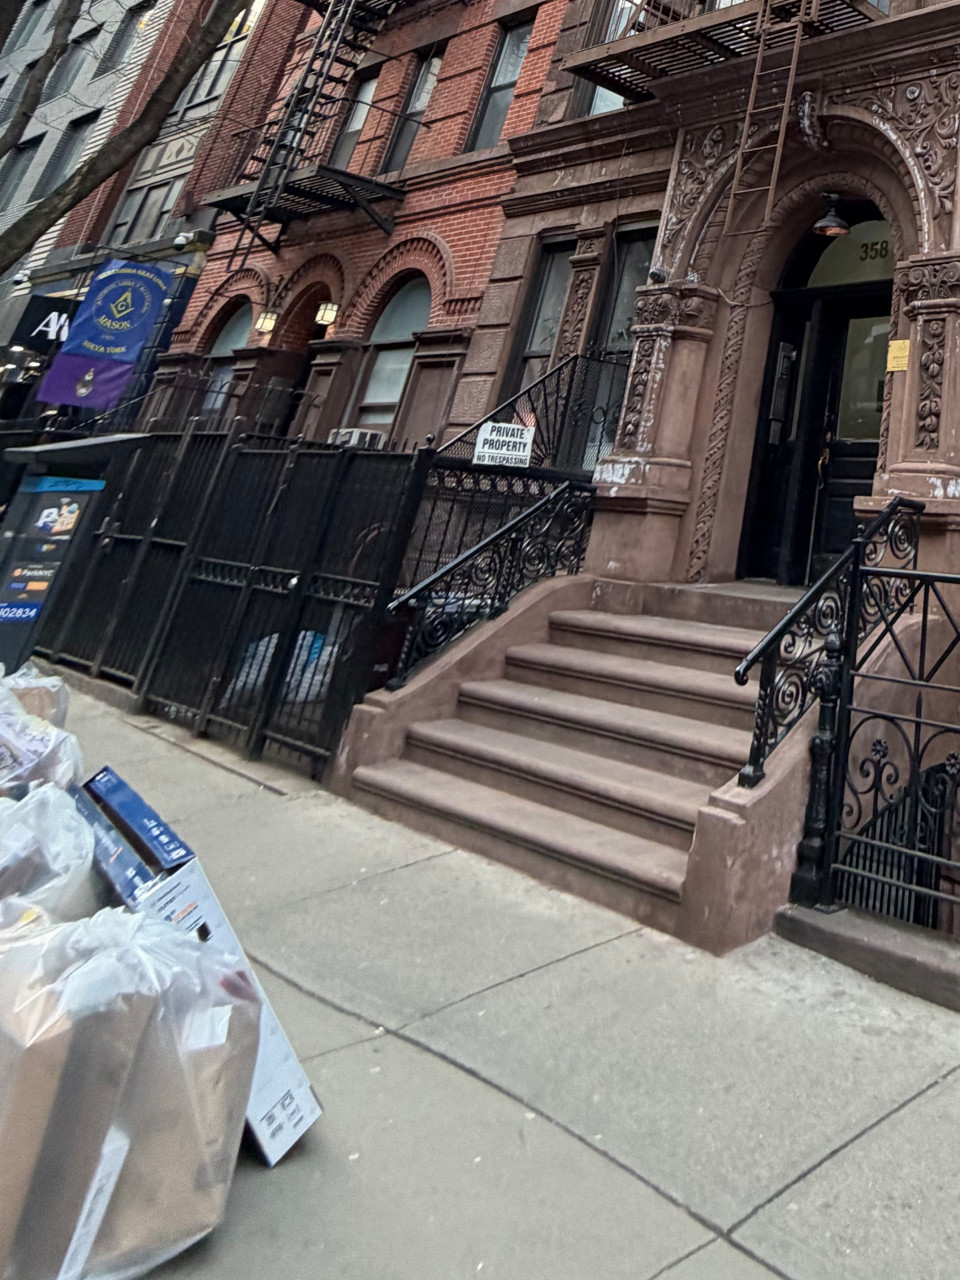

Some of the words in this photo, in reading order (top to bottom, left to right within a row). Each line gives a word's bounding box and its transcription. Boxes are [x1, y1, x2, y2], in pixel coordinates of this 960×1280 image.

[860, 240, 889, 261] 358
[98, 314, 131, 330] MASON
[489, 425, 525, 439] PRIVATE
[481, 438, 528, 453] PROPERTY
[476, 454, 486, 462] NO
[487, 454, 528, 466] TRESPASSING
